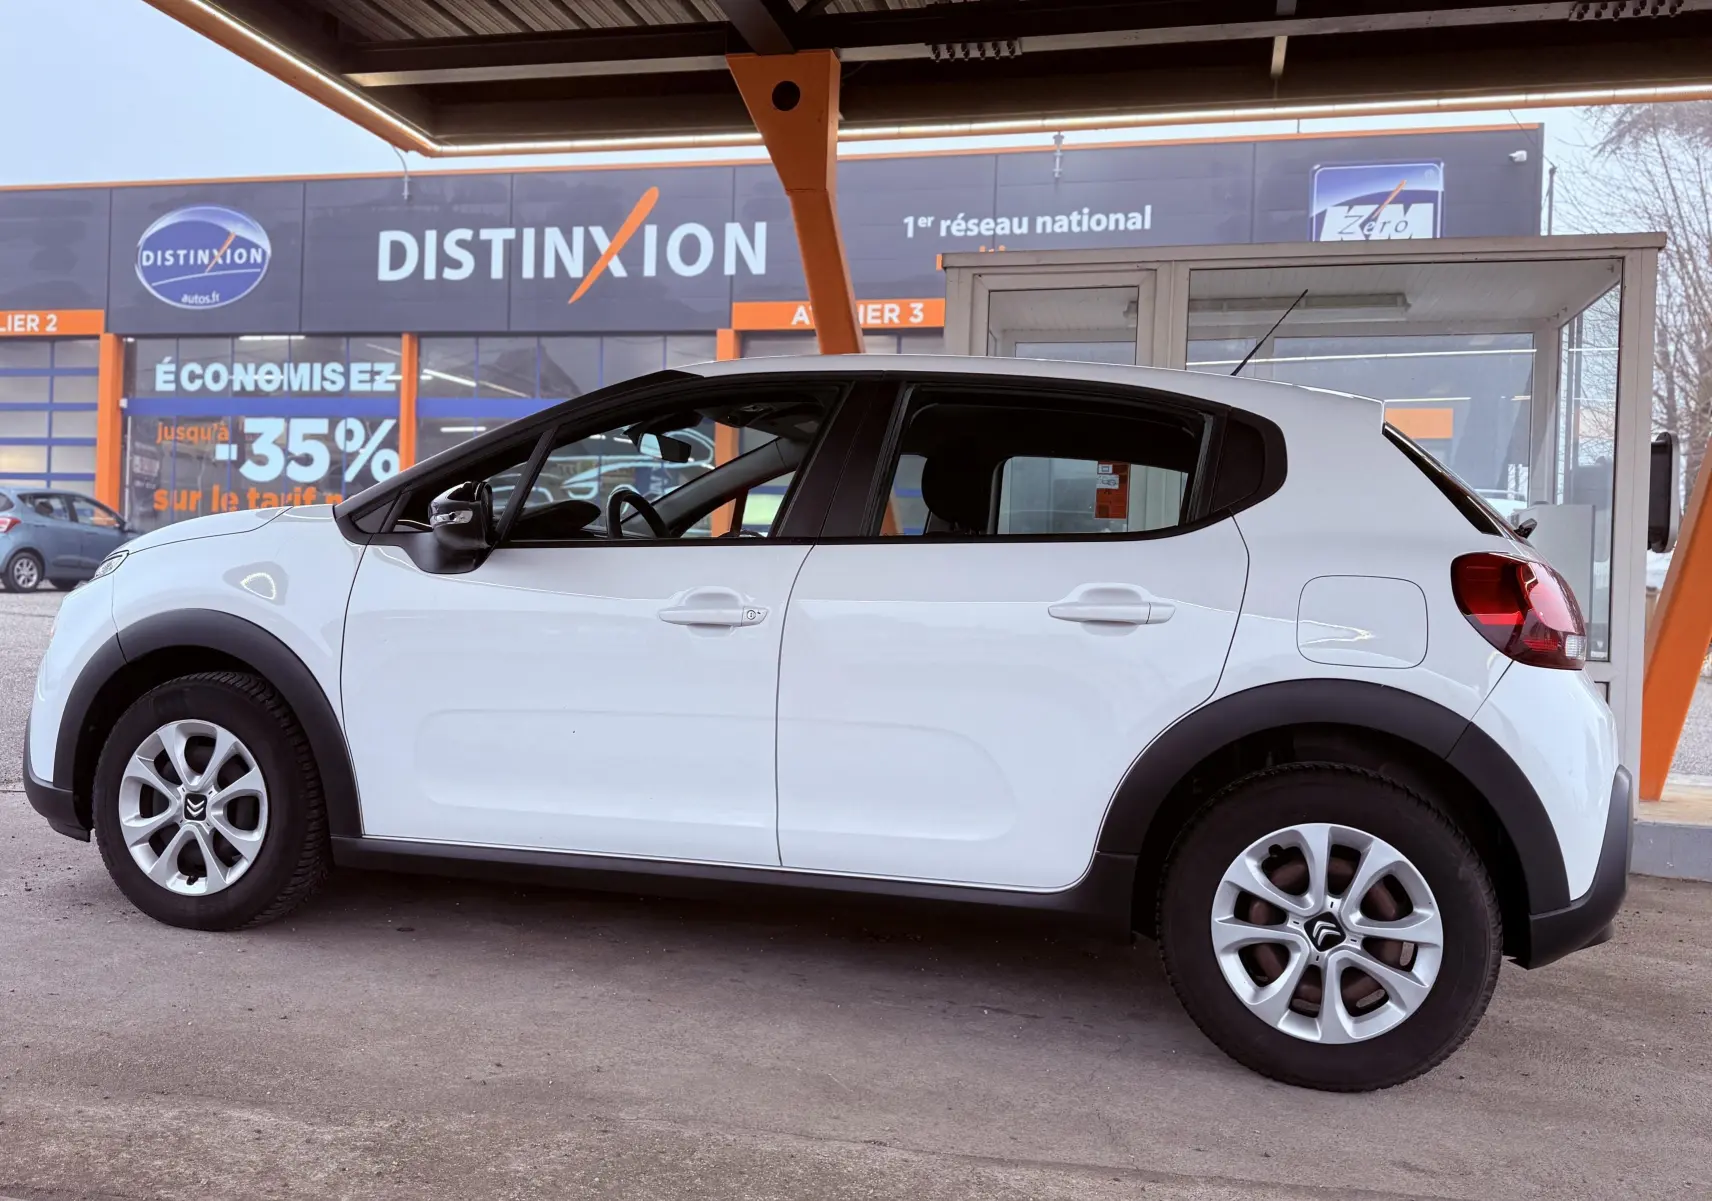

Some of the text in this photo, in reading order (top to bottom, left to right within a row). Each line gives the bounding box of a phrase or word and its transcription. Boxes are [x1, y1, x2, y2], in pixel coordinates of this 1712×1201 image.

[939, 212, 1029, 237] réseau
[1036, 204, 1152, 234] national
[377, 187, 767, 304] DISTINXION
[181, 290, 220, 305] autos.fr
[45, 313, 58, 332] 2
[908, 302, 924, 324] 3
[155, 357, 397, 392] ÉCONOMISEZ
[156, 421, 230, 444] jusqu'à
[215, 417, 400, 483] -35%
[153, 489, 202, 511] sur
[211, 484, 239, 512] le
[247, 486, 317, 510] tarif
